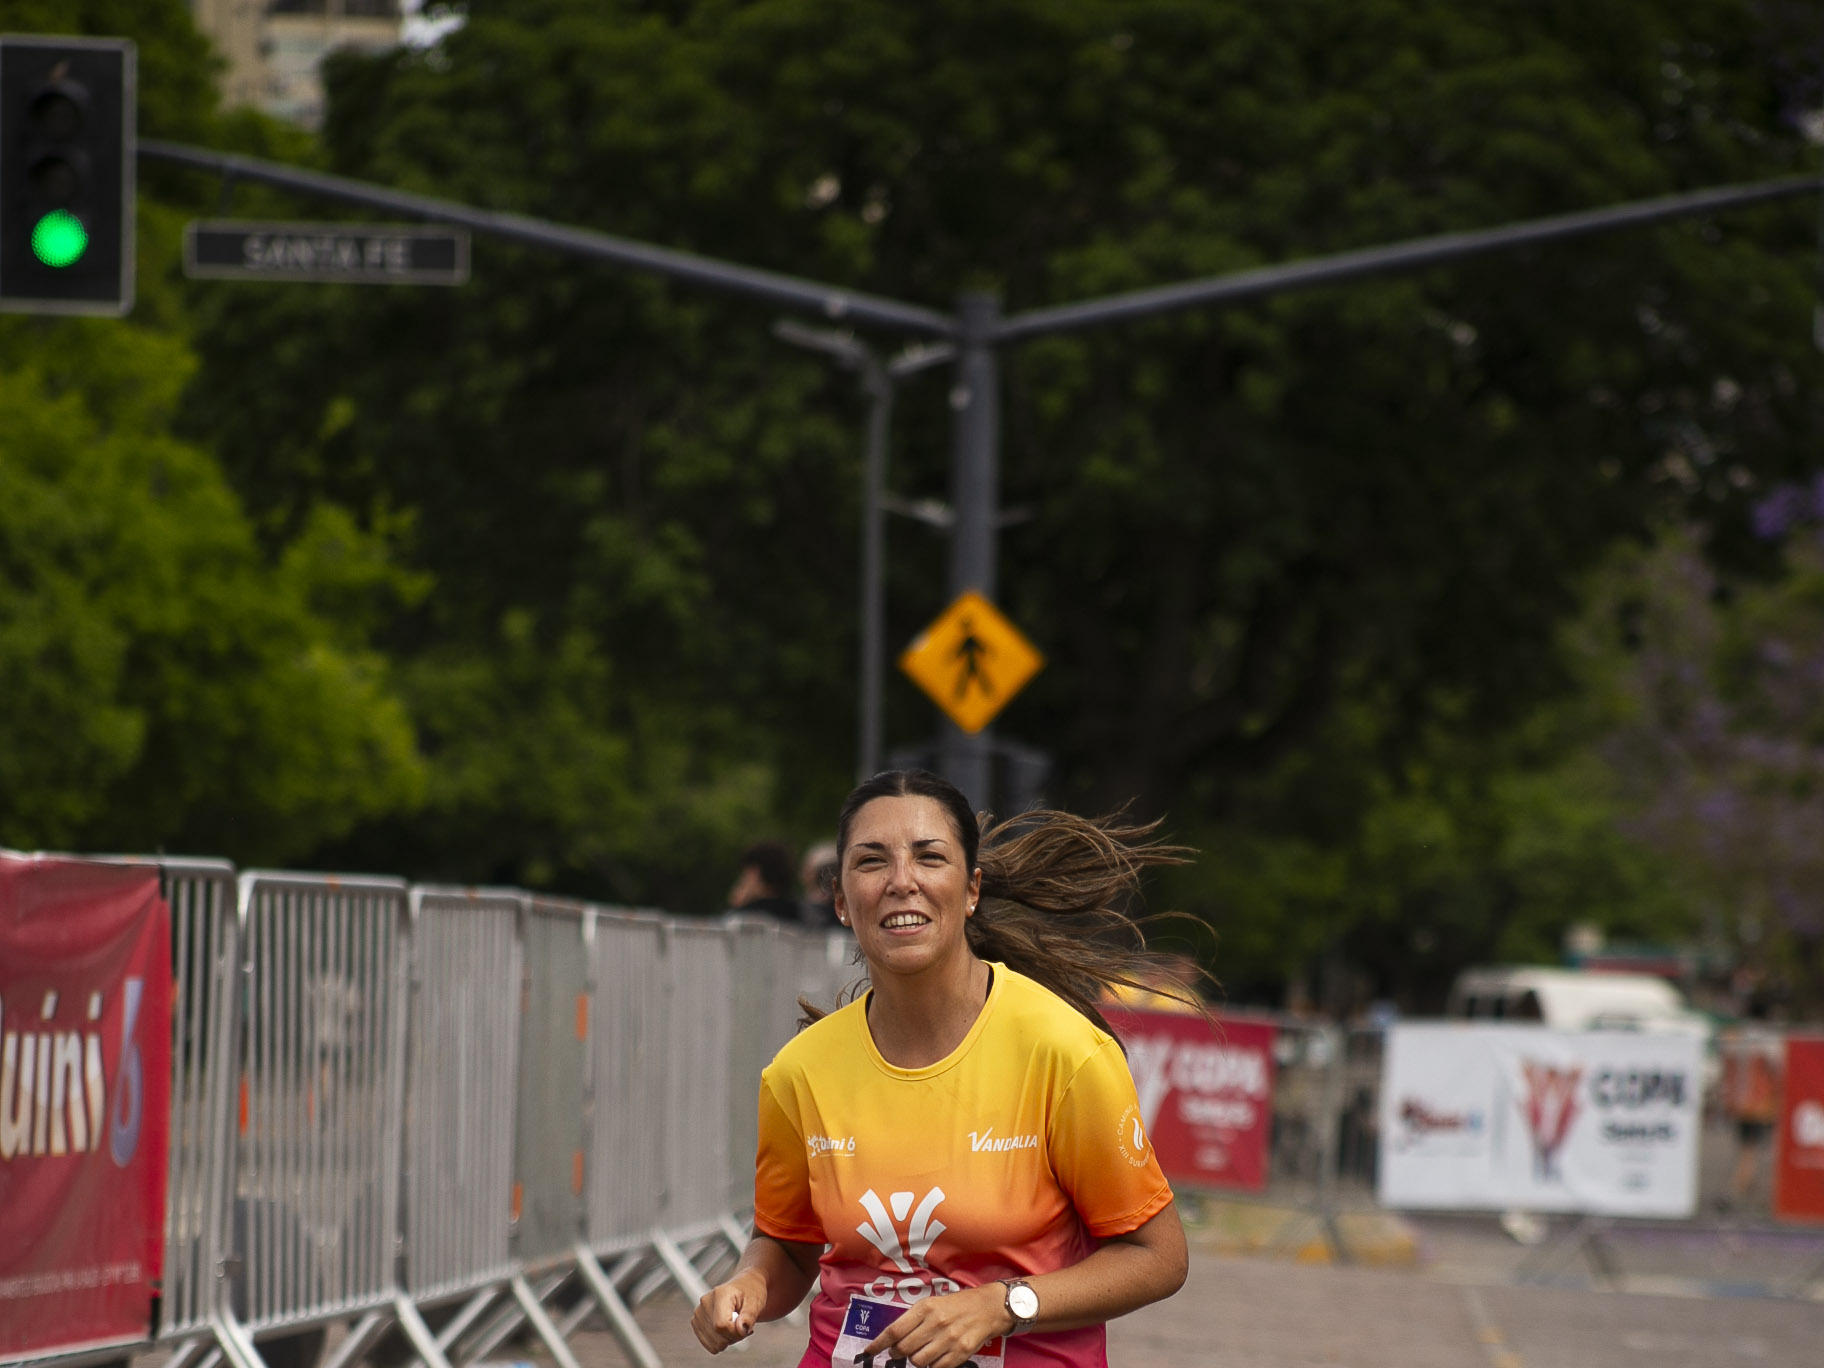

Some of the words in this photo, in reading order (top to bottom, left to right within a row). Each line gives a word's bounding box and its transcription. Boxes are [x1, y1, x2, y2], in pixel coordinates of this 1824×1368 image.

[243, 232, 361, 271] SANTA
[363, 234, 411, 273] FE
[0, 989, 106, 1160] uini
[109, 976, 144, 1169] 6
[847, 1136, 856, 1151] 6
[968, 1126, 1038, 1152] VANDALIA
[864, 1276, 963, 1304] COP
[855, 1324, 870, 1332] COPA
